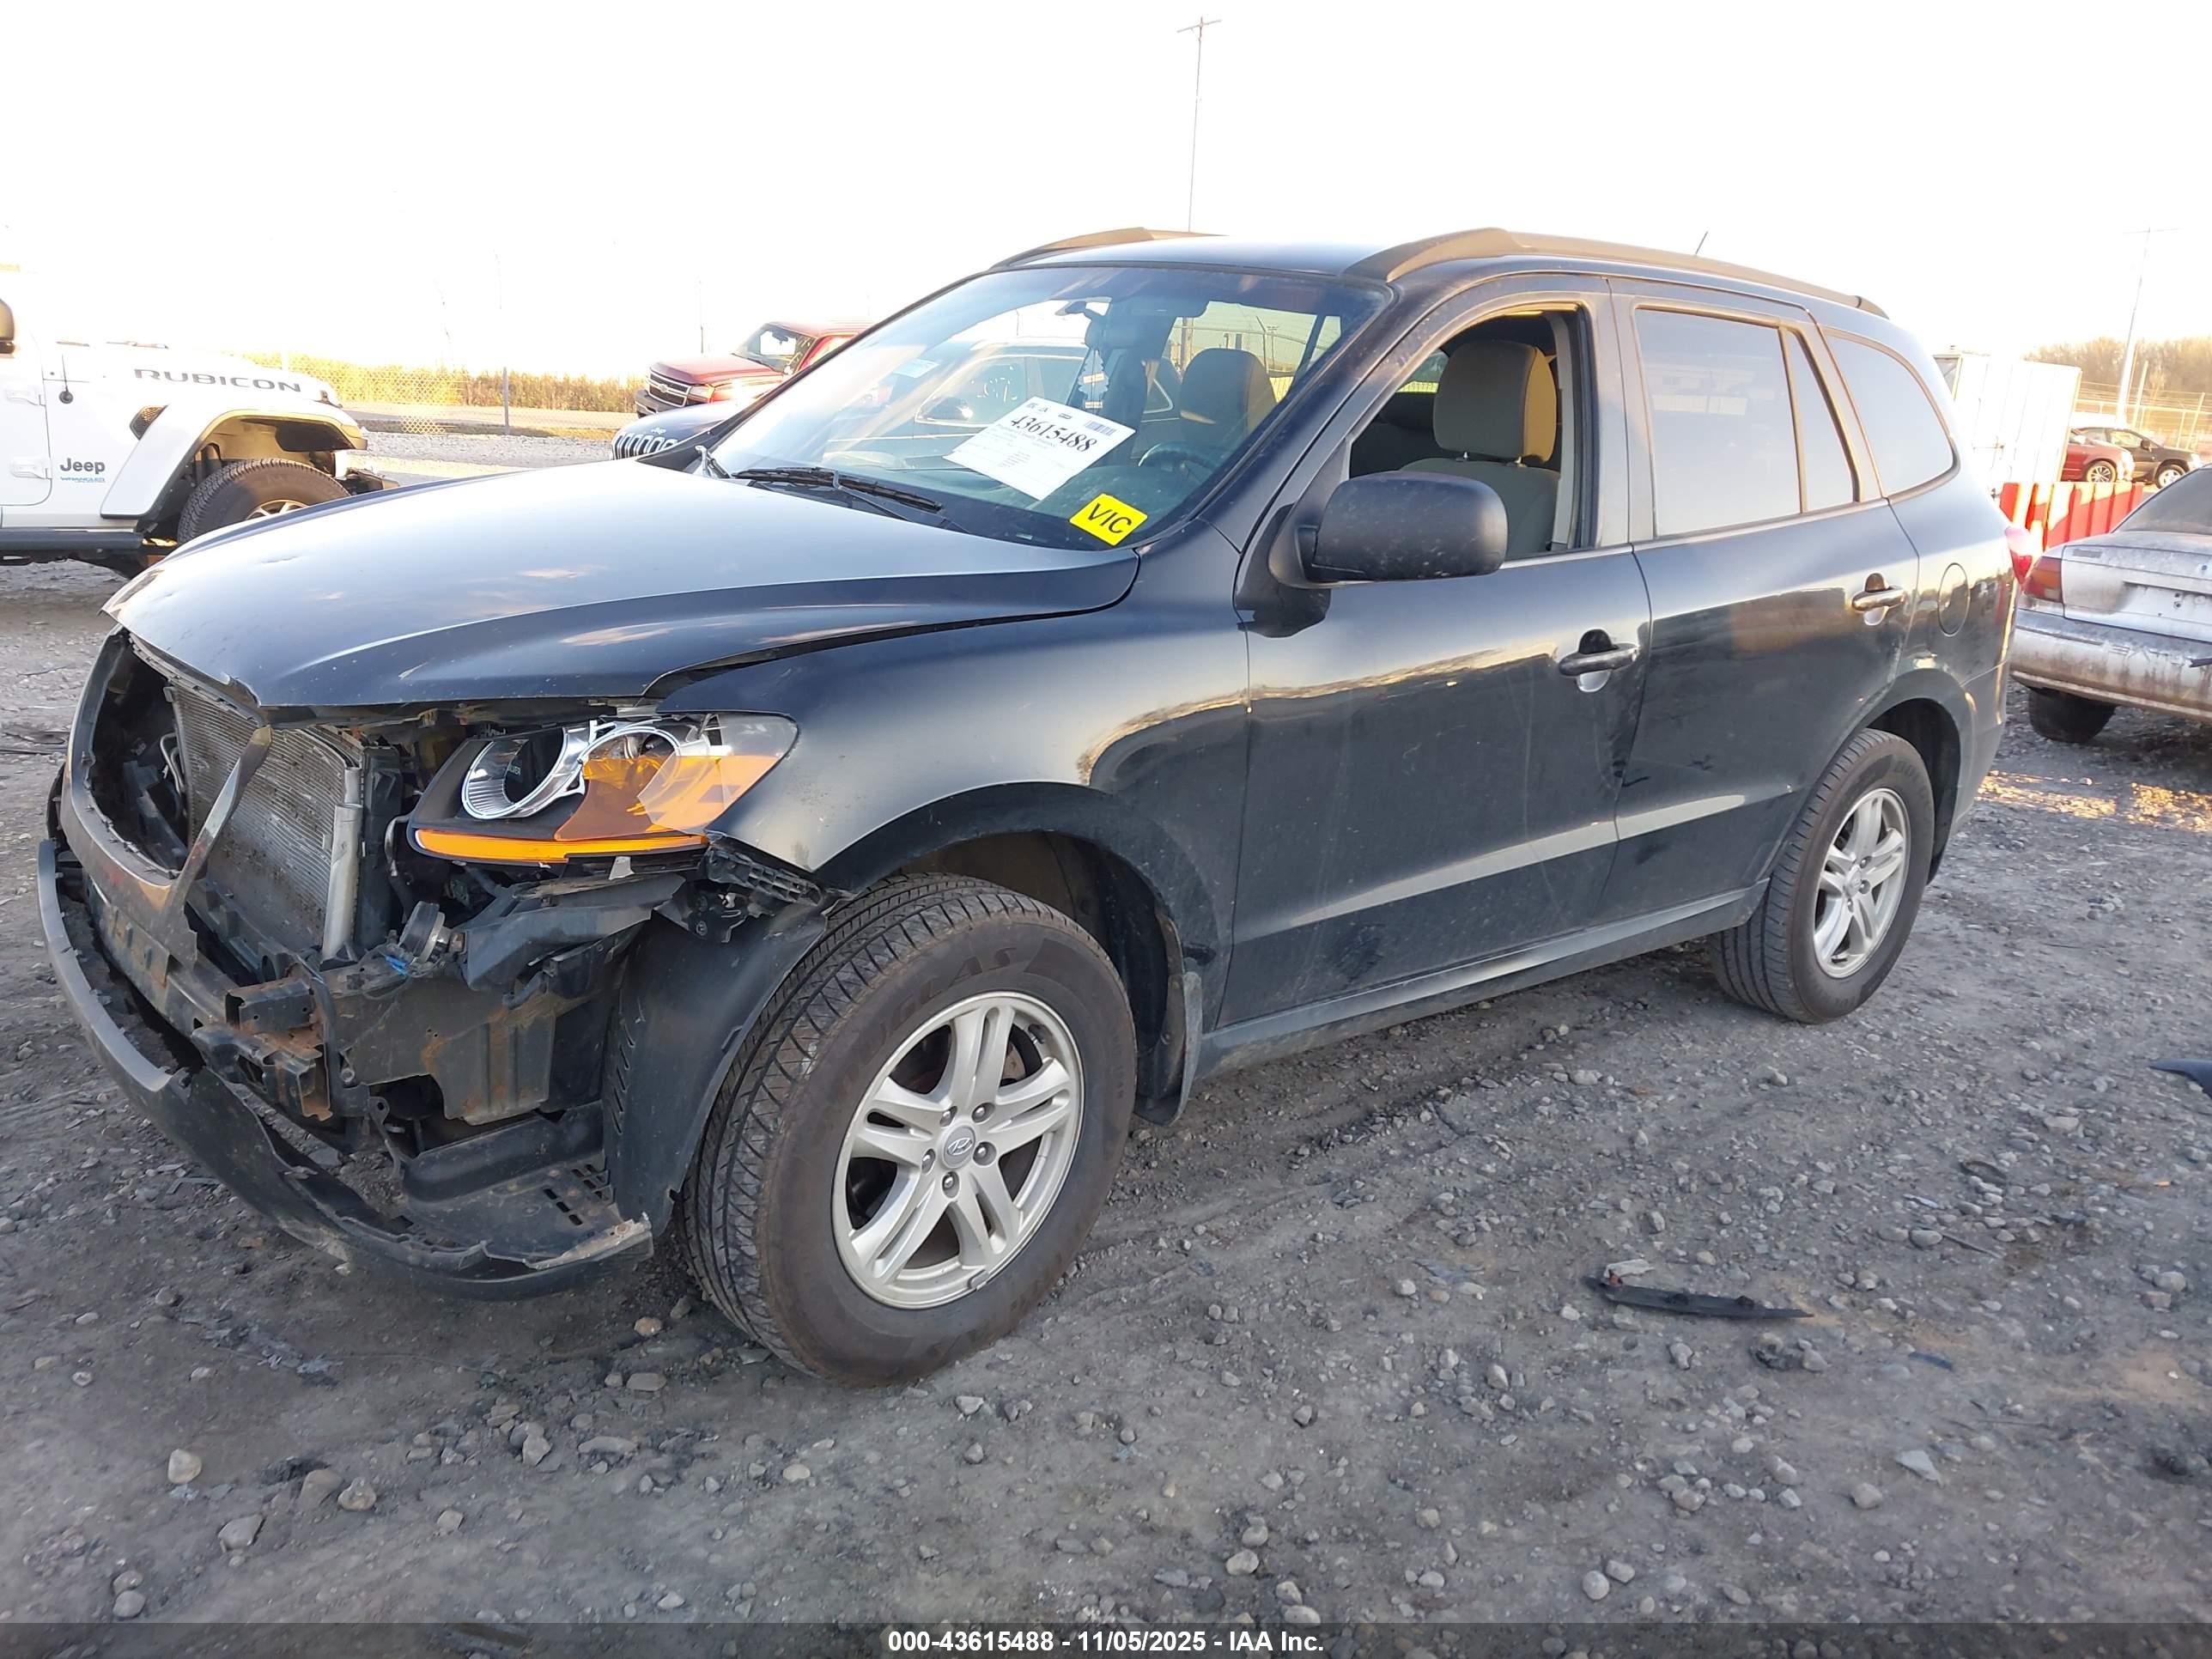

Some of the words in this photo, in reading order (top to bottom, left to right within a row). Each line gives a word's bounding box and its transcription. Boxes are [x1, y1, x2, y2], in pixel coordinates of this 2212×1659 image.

[134, 368, 301, 393] RUBICON
[1011, 415, 1097, 453] 43615488
[59, 457, 106, 475] Jeep
[1086, 503, 1133, 535] VIC
